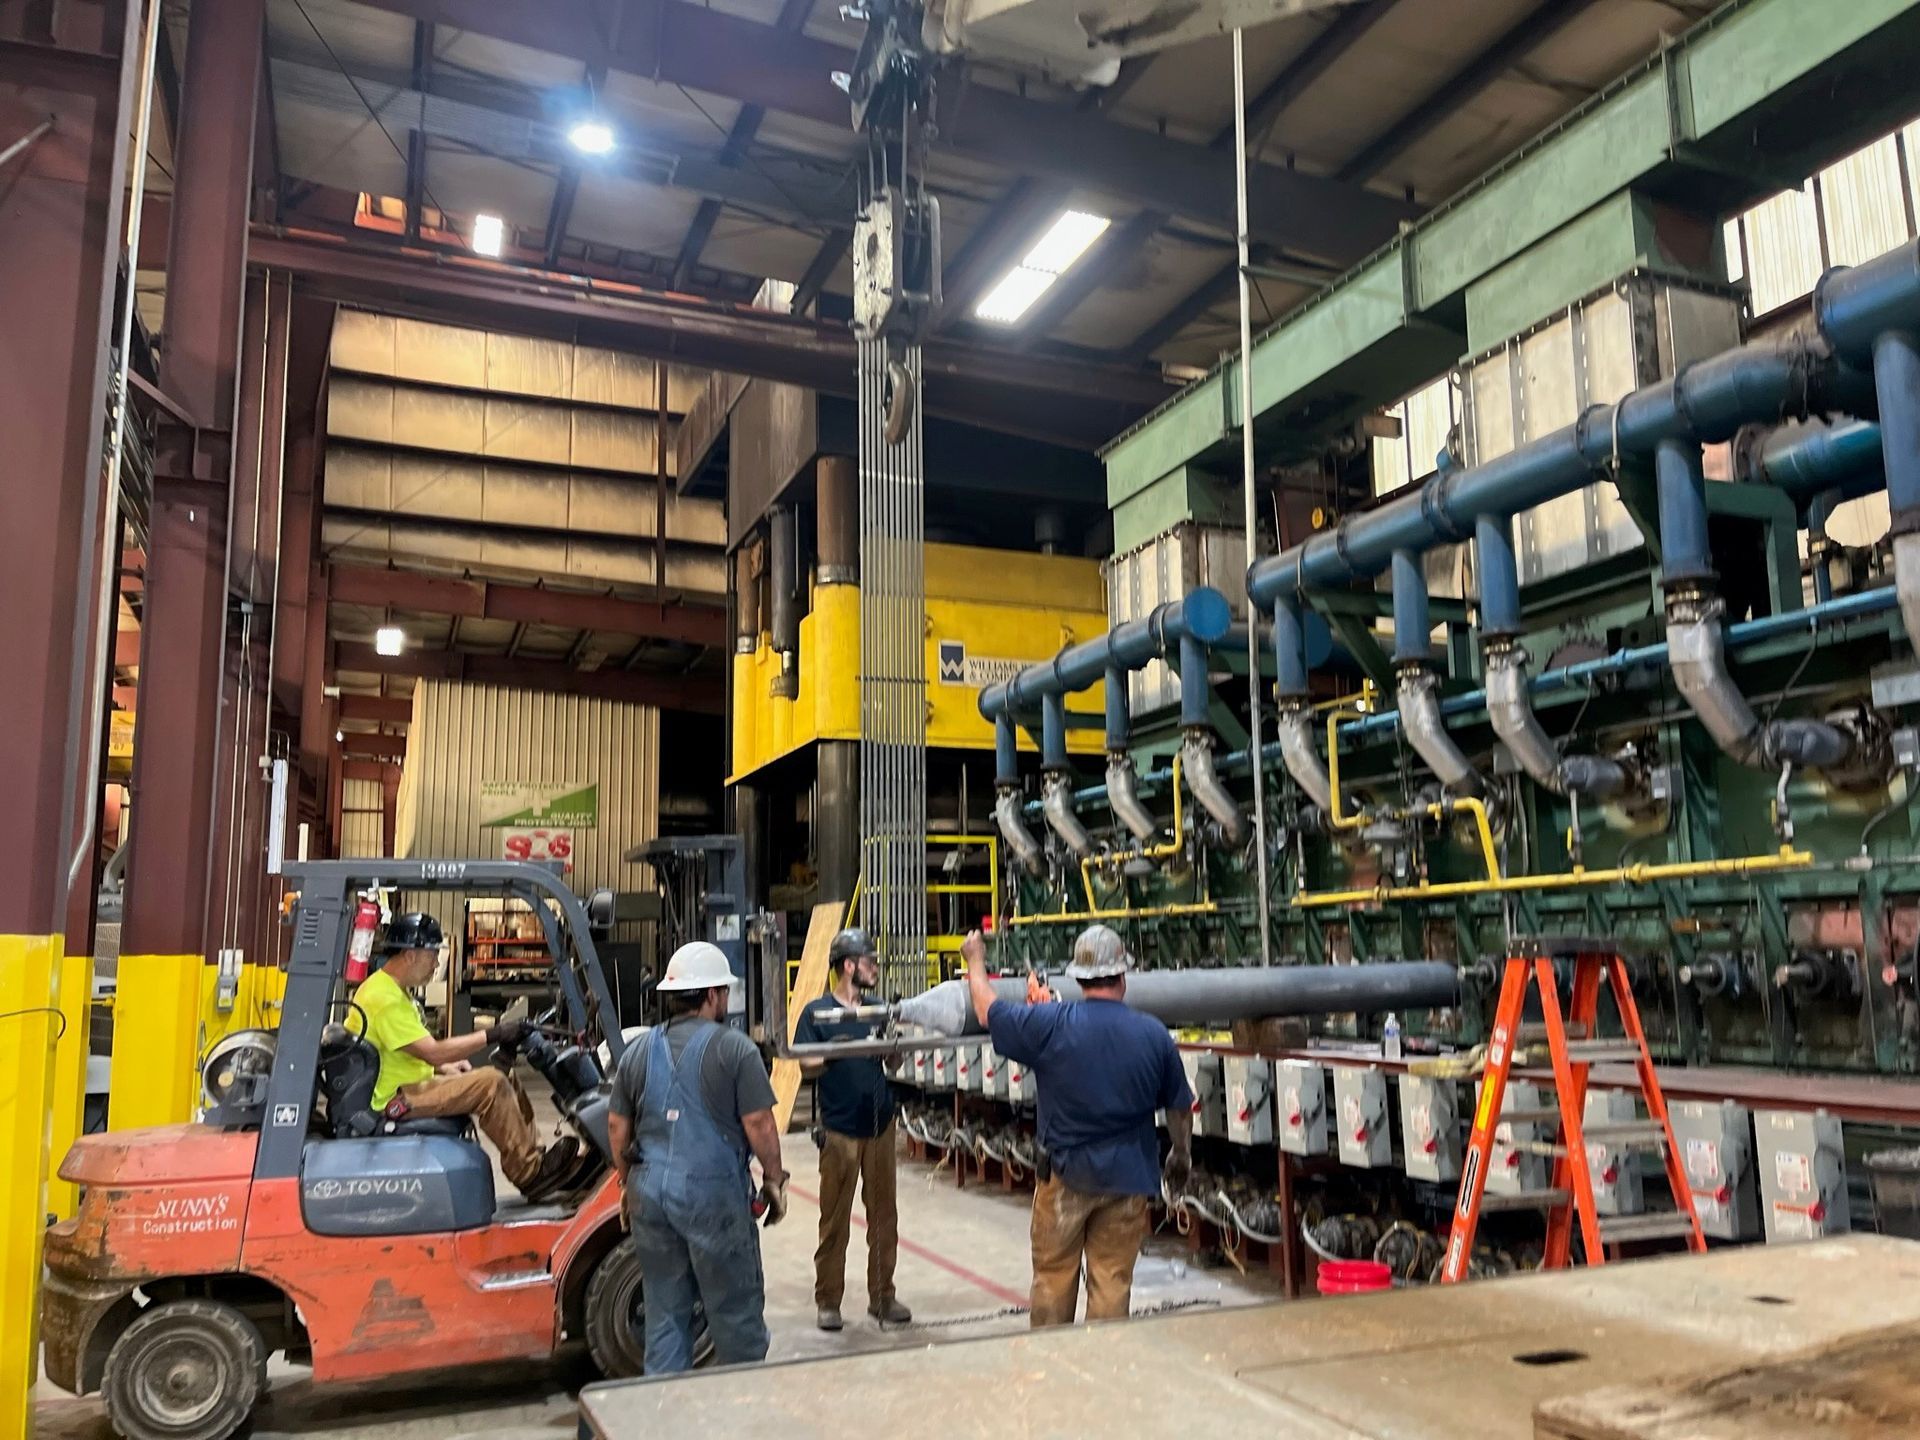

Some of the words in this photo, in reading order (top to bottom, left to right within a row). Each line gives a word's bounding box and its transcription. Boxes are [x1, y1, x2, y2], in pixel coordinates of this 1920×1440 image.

[969, 659, 1018, 673] WILLIAMS
[979, 672, 1013, 683] COMP
[520, 782, 566, 790] PROTECTS
[550, 812, 593, 820] QUALITY
[514, 818, 565, 827] PROTECTS
[346, 1178, 423, 1196] TOYOTA
[153, 1193, 230, 1219] NUNN'S
[143, 1216, 238, 1235] Construction
